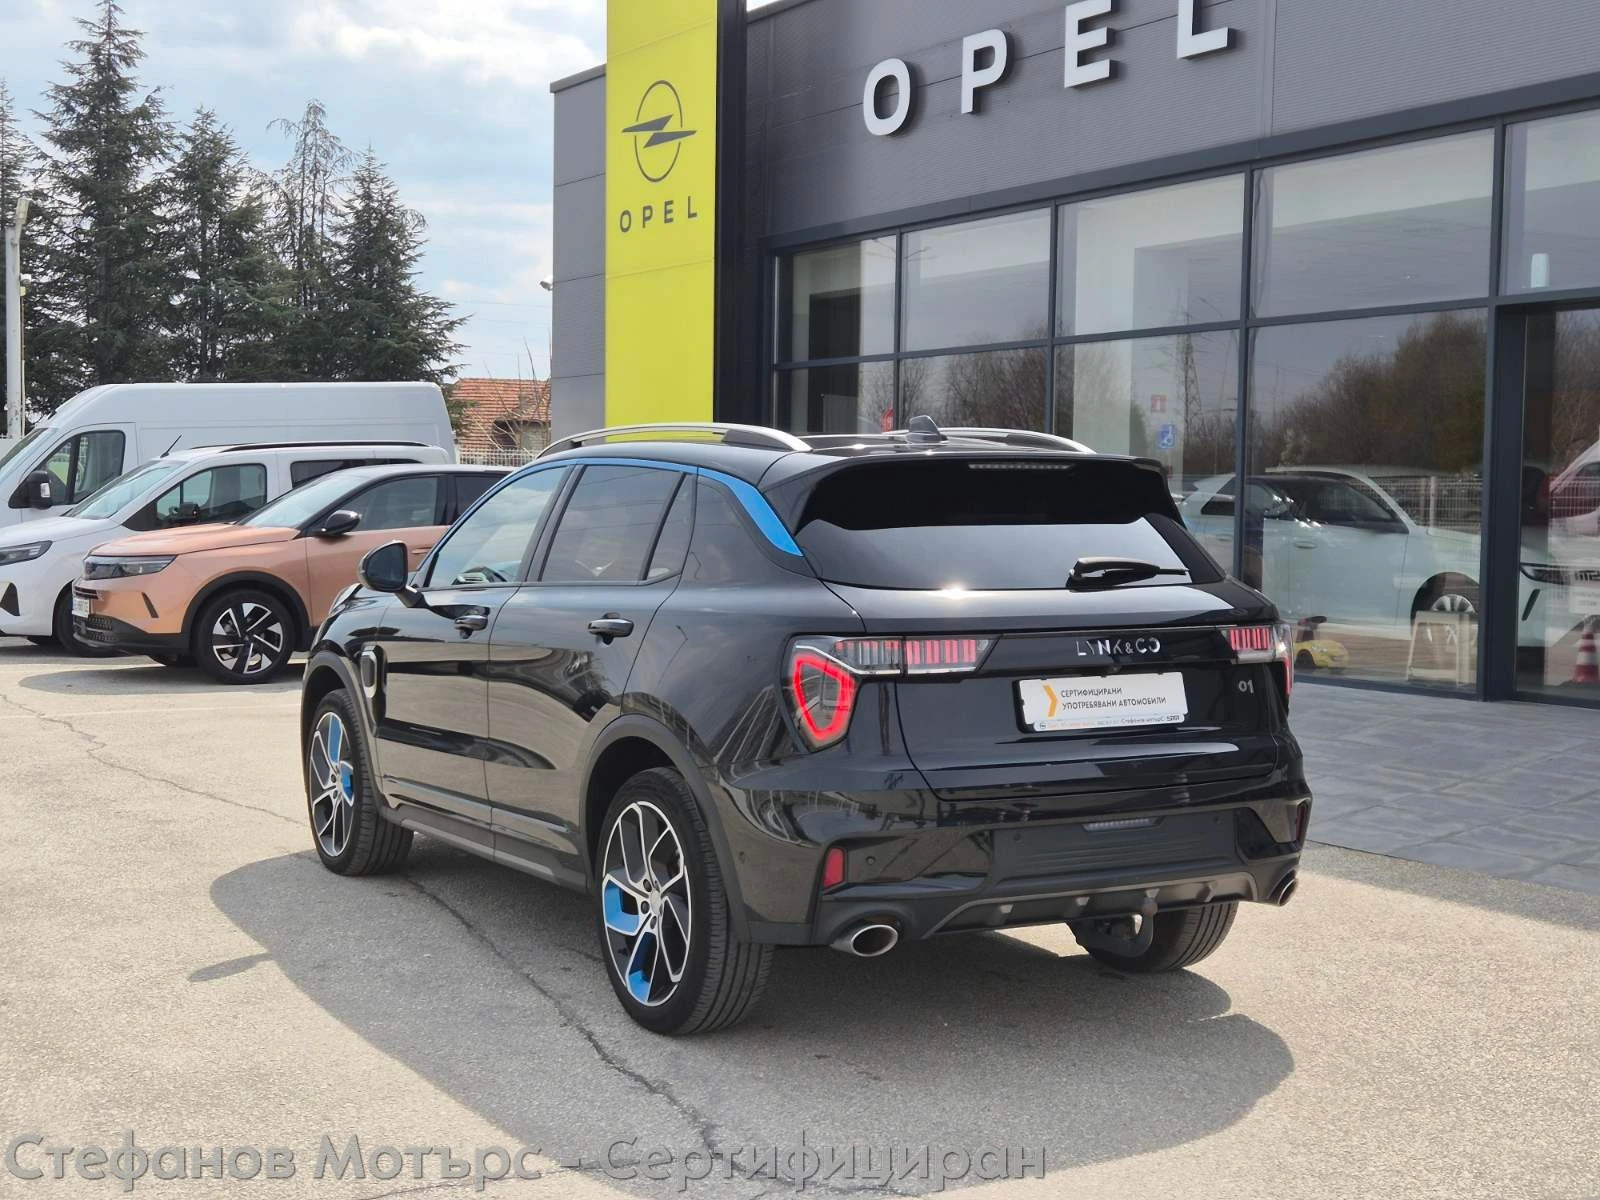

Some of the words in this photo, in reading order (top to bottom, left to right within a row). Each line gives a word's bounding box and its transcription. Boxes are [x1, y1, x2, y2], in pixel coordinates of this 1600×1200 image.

[863, 0, 1230, 136] OPEL
[620, 195, 698, 233] OPEL
[1060, 687, 1122, 699] СЕРТИФИЦИРАНИ
[1238, 679, 1255, 694] 01
[1062, 699, 1117, 711] УПОТРЕБЯВАНИ
[1118, 696, 1167, 707] АВТОМОБИЛИ
